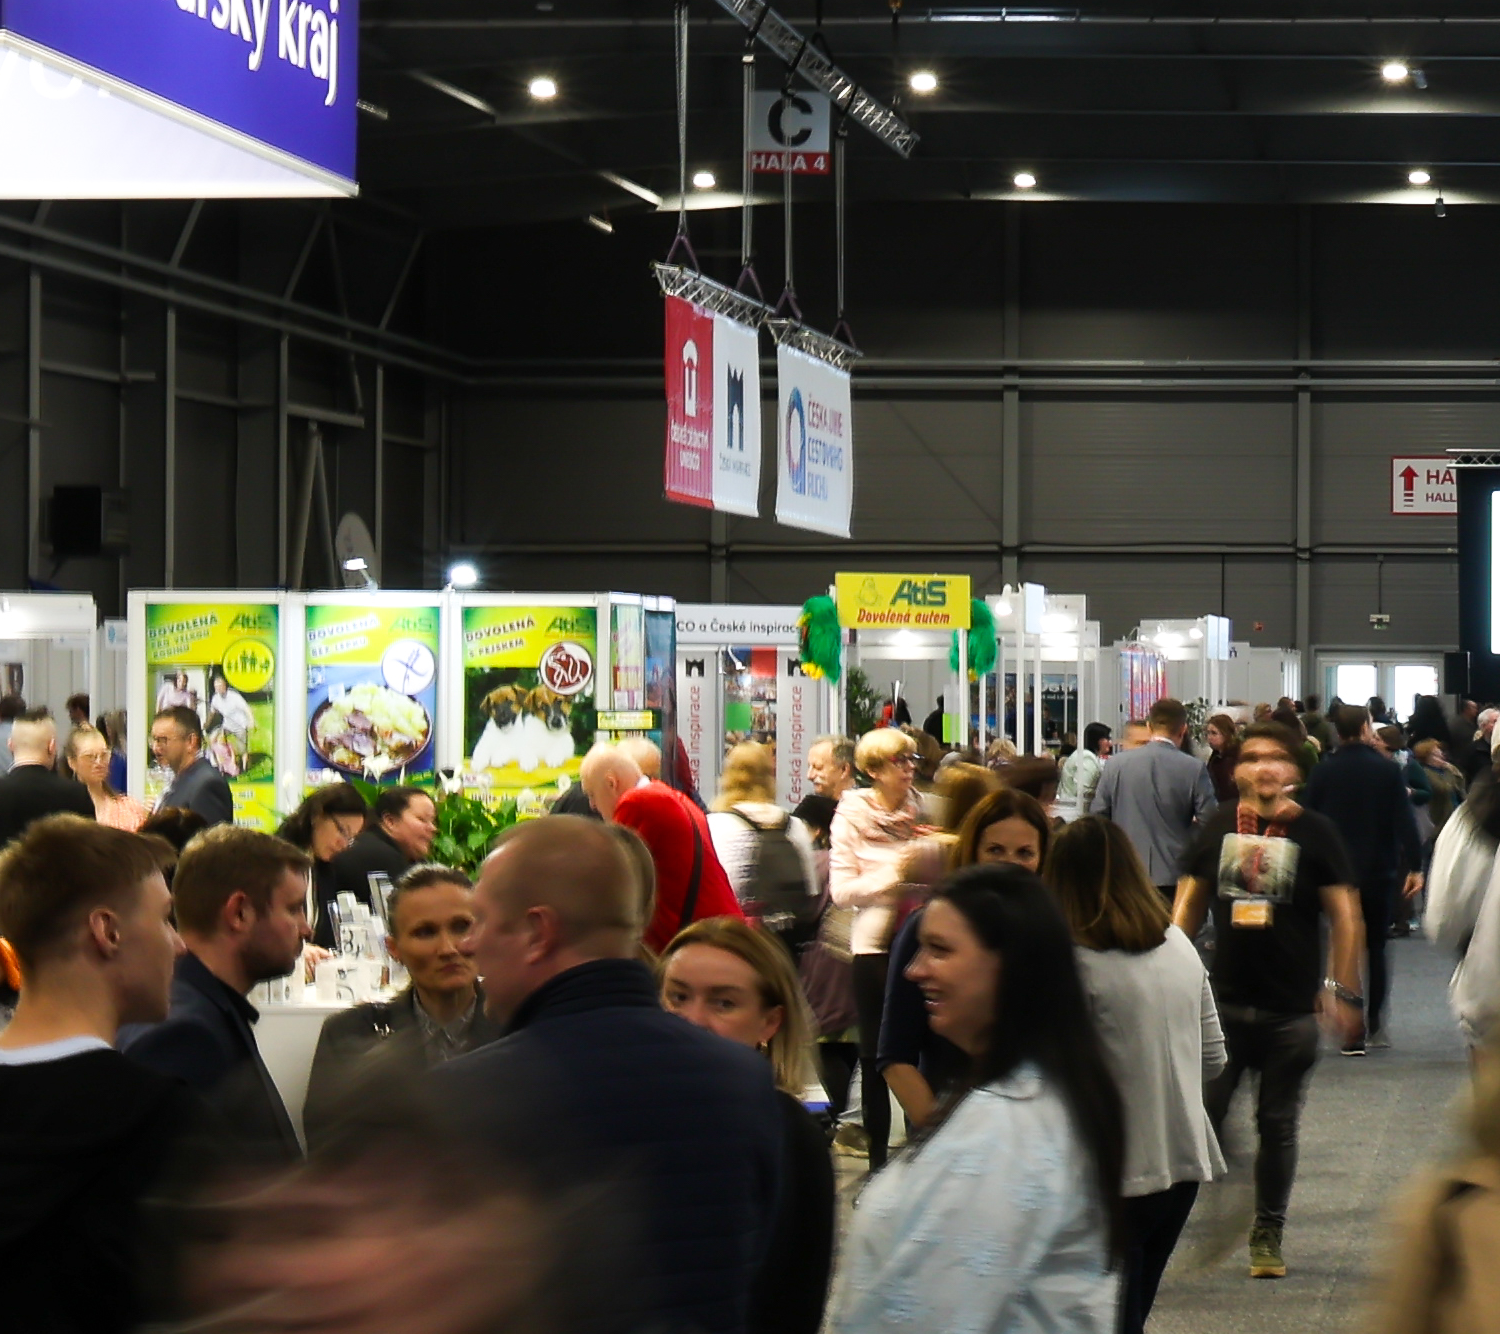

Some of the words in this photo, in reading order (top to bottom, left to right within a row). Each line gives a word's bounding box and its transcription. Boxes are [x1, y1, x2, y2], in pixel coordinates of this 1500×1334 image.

[767, 95, 813, 147] C
[813, 154, 826, 171] 4
[1426, 469, 1455, 485] HA
[1425, 492, 1457, 503] HALL
[890, 579, 947, 607] AtiS
[857, 608, 911, 624] Dovolená
[914, 611, 950, 624] autem
[465, 615, 535, 643] DOVOLENÁ
[699, 623, 707, 633] a
[710, 618, 746, 634] České
[749, 619, 800, 636] inspirac
[789, 685, 805, 754] inspirace
